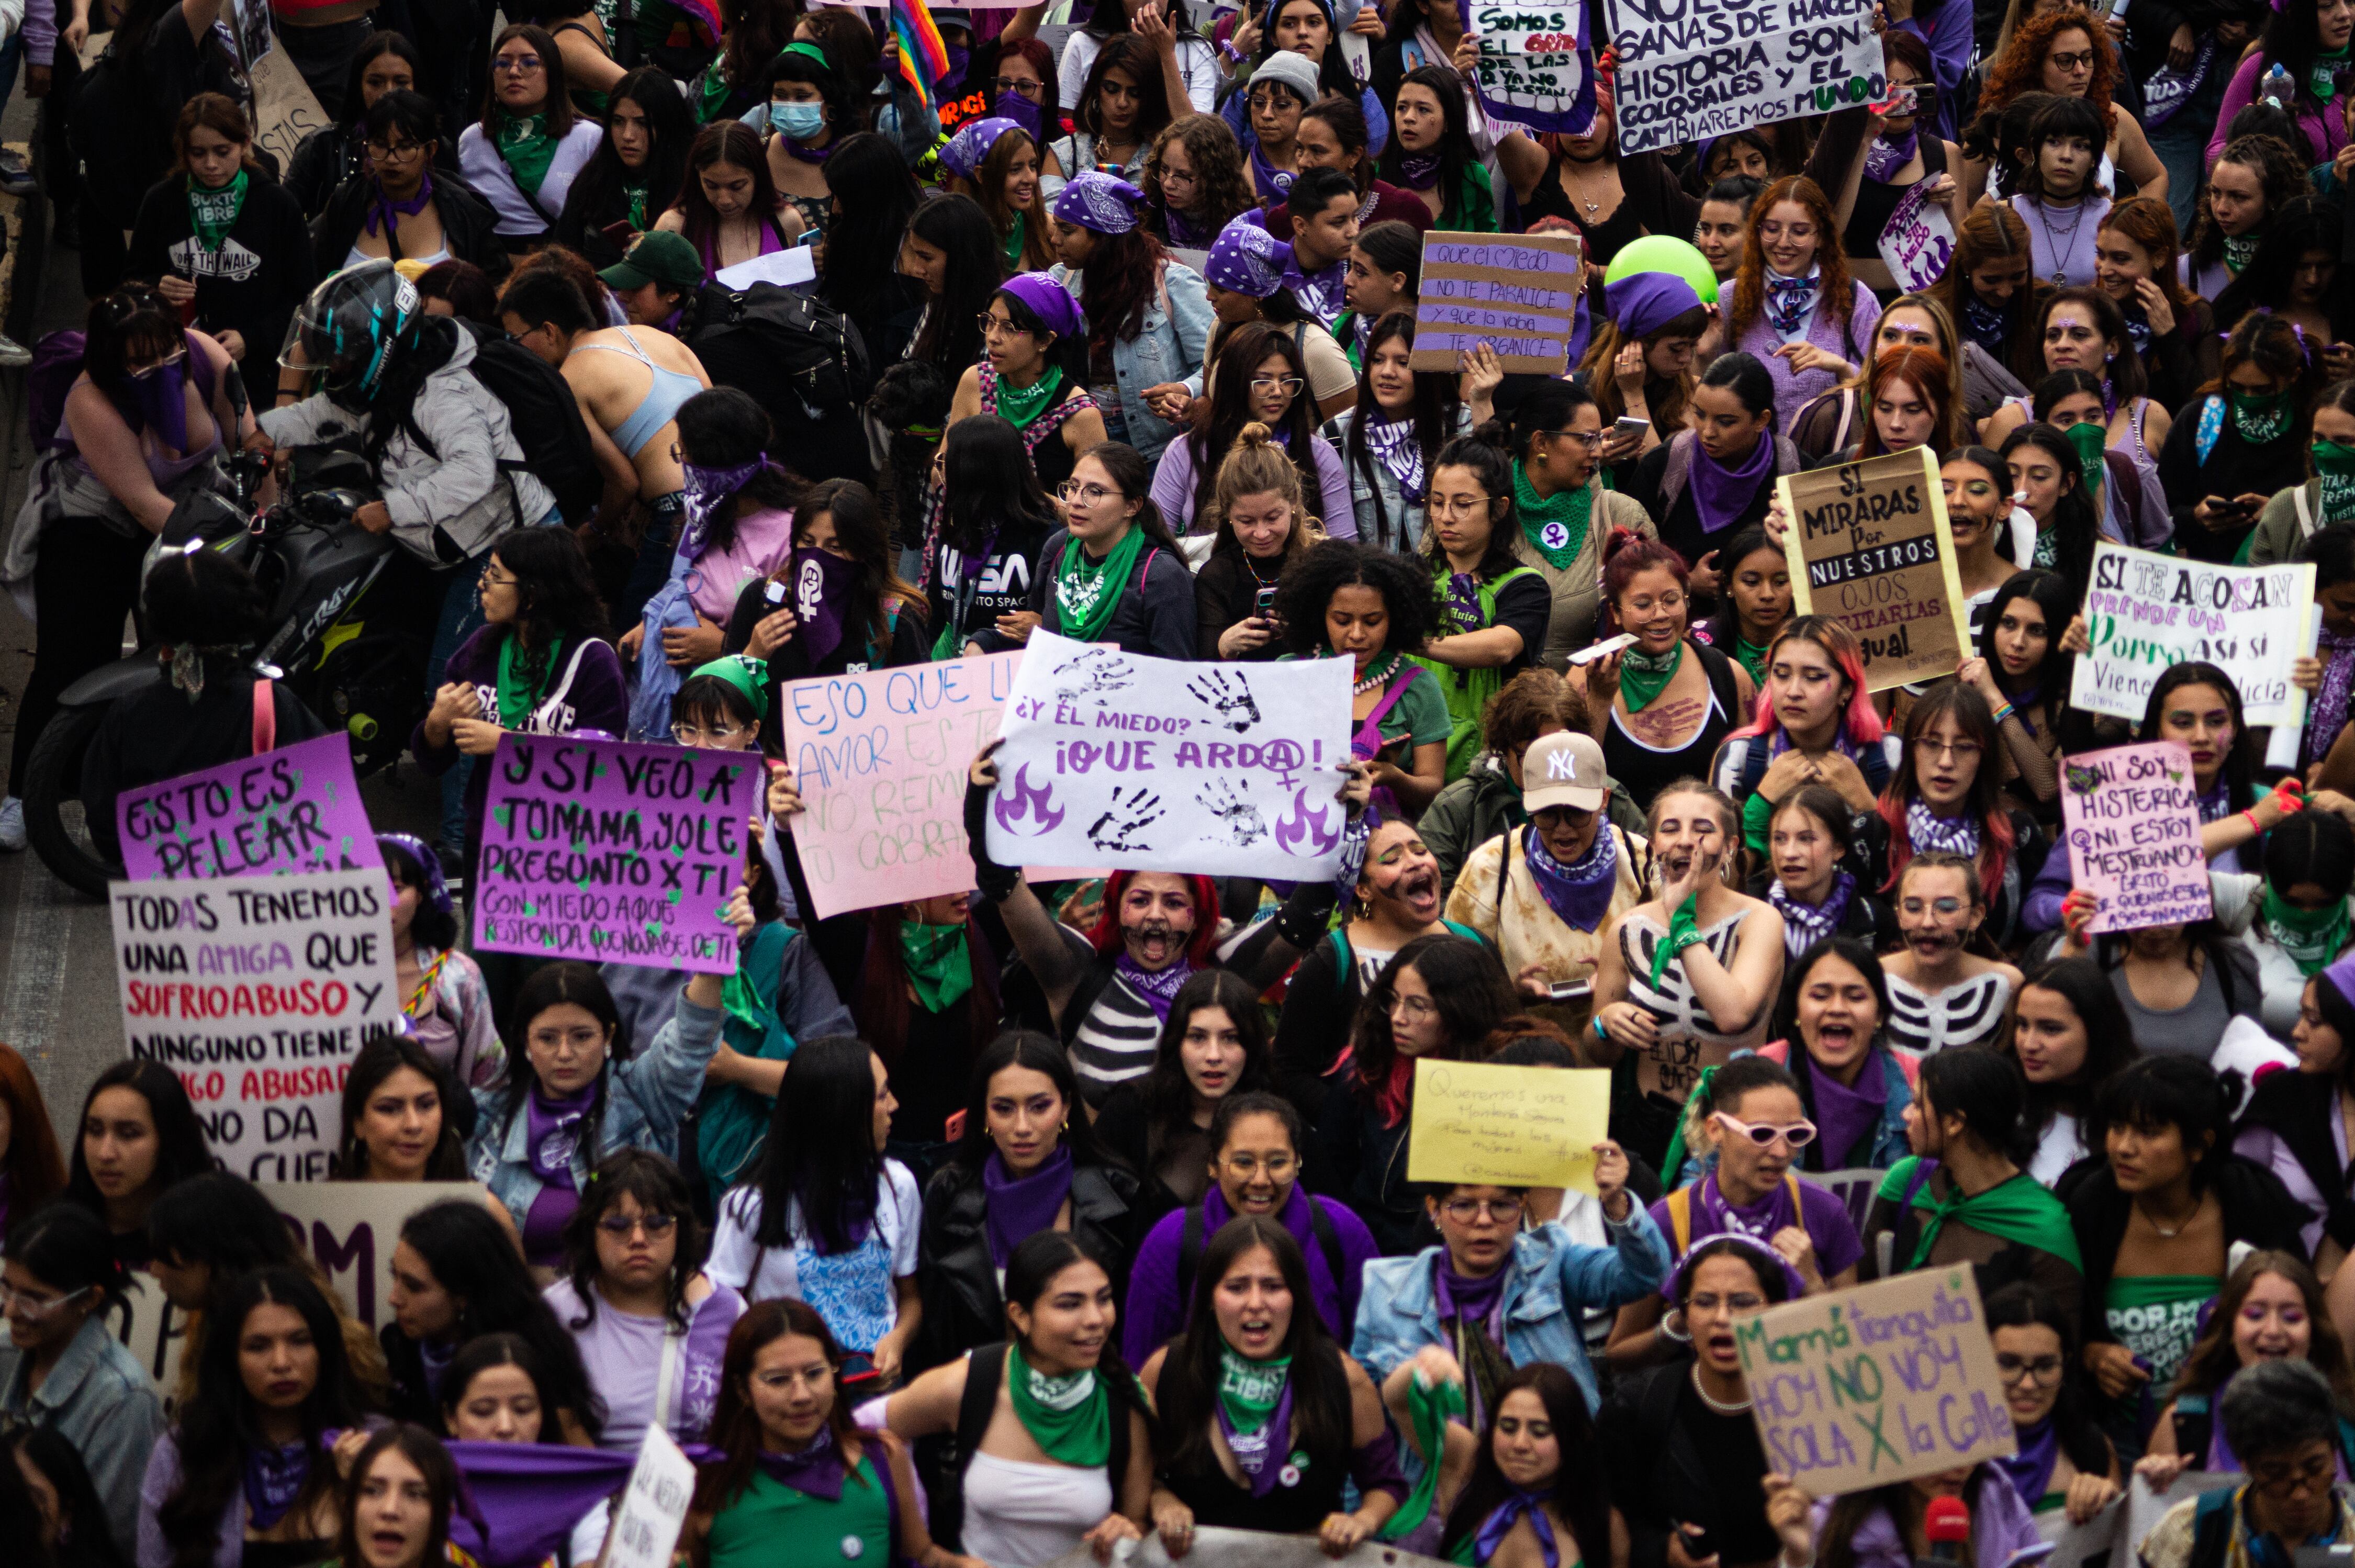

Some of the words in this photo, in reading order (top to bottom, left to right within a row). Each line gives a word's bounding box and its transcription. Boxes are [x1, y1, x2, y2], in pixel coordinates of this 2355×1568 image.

[1478, 7, 1566, 34] SOMOS
[1613, 13, 1733, 63] GANAS
[1737, 5, 1780, 37] DE
[1478, 39, 1521, 56] EL
[1478, 58, 1516, 71] DE
[1524, 54, 1570, 70] LAS
[1616, 41, 1770, 106] HISTORIA
[1787, 20, 1860, 63] SON
[1480, 71, 1498, 86] Q
[1500, 70, 1524, 85] YA
[1529, 73, 1557, 86] NO
[1775, 68, 1794, 88] Y
[1810, 55, 1852, 84] EL
[1620, 99, 1788, 153] CAMBIAREMOS
[1794, 72, 1885, 113] MUNDO
[190, 189, 237, 208] BORT
[197, 206, 236, 222] IBRE
[1901, 226, 1931, 270] MIEDO
[1437, 280, 1454, 296] NO
[1464, 280, 1478, 299] TE
[1489, 281, 1558, 309] PARALICE
[1451, 308, 1476, 327] que
[1449, 334, 1466, 351] TE
[1839, 464, 1865, 497] SI
[1802, 485, 1922, 540] MIRARAS
[940, 543, 1031, 593] NSA
[1810, 538, 1935, 586] NUESTROS
[997, 596, 1029, 608] SPAC
[1841, 573, 1908, 611] OJOS
[2096, 554, 2128, 590] SI
[2135, 560, 2168, 601] TE
[2170, 569, 2293, 613] ACOSAN
[1838, 598, 1942, 632] RITARÍAS
[2090, 591, 2181, 626] PRENDE
[2188, 608, 2226, 635] UN
[1861, 624, 1913, 667] gual.
[792, 680, 867, 734] ESO
[887, 665, 970, 714] QUE
[1016, 696, 1046, 722] ¿Y
[1096, 710, 1192, 735] MIEDO?
[502, 745, 534, 785] Y
[542, 747, 596, 793] SI
[616, 754, 694, 800] VEO
[703, 765, 735, 806] A
[798, 725, 892, 793] AMOR
[904, 718, 952, 767] ES
[1056, 740, 1157, 775] ¡QUE
[2127, 755, 2168, 781] SOY
[126, 780, 230, 842] ESTO
[240, 757, 296, 813] ES
[803, 792, 857, 836] NO
[2081, 786, 2197, 820] HISTÉRICA
[155, 800, 332, 881] PELEAR
[2094, 826, 2119, 849] NI
[2130, 816, 2192, 845] ESTOY
[481, 844, 651, 886] PREGUNTO
[660, 859, 683, 889] X
[692, 863, 729, 897] TI
[2083, 844, 2204, 878] MESTRUANDO
[116, 893, 219, 933] TODAS
[228, 886, 380, 926] TENEMOS
[481, 885, 526, 916] CON
[536, 891, 611, 922] MIEDO
[124, 942, 189, 975] UNA
[196, 941, 294, 977] AMIGA
[306, 931, 379, 973] QUE
[354, 981, 383, 1016] Y
[131, 1033, 267, 1066] NINGUNO
[271, 1027, 353, 1060] TIENE
[263, 1104, 319, 1145] DA
[1735, 1305, 1851, 1372] Mamá
[1752, 1368, 1824, 1424] HOY
[1825, 1351, 1885, 1409] NO
[1889, 1335, 1966, 1394] VOY
[1767, 1420, 1857, 1479] SOLA
[1853, 1403, 1902, 1473] X
[1898, 1402, 1935, 1455] la
